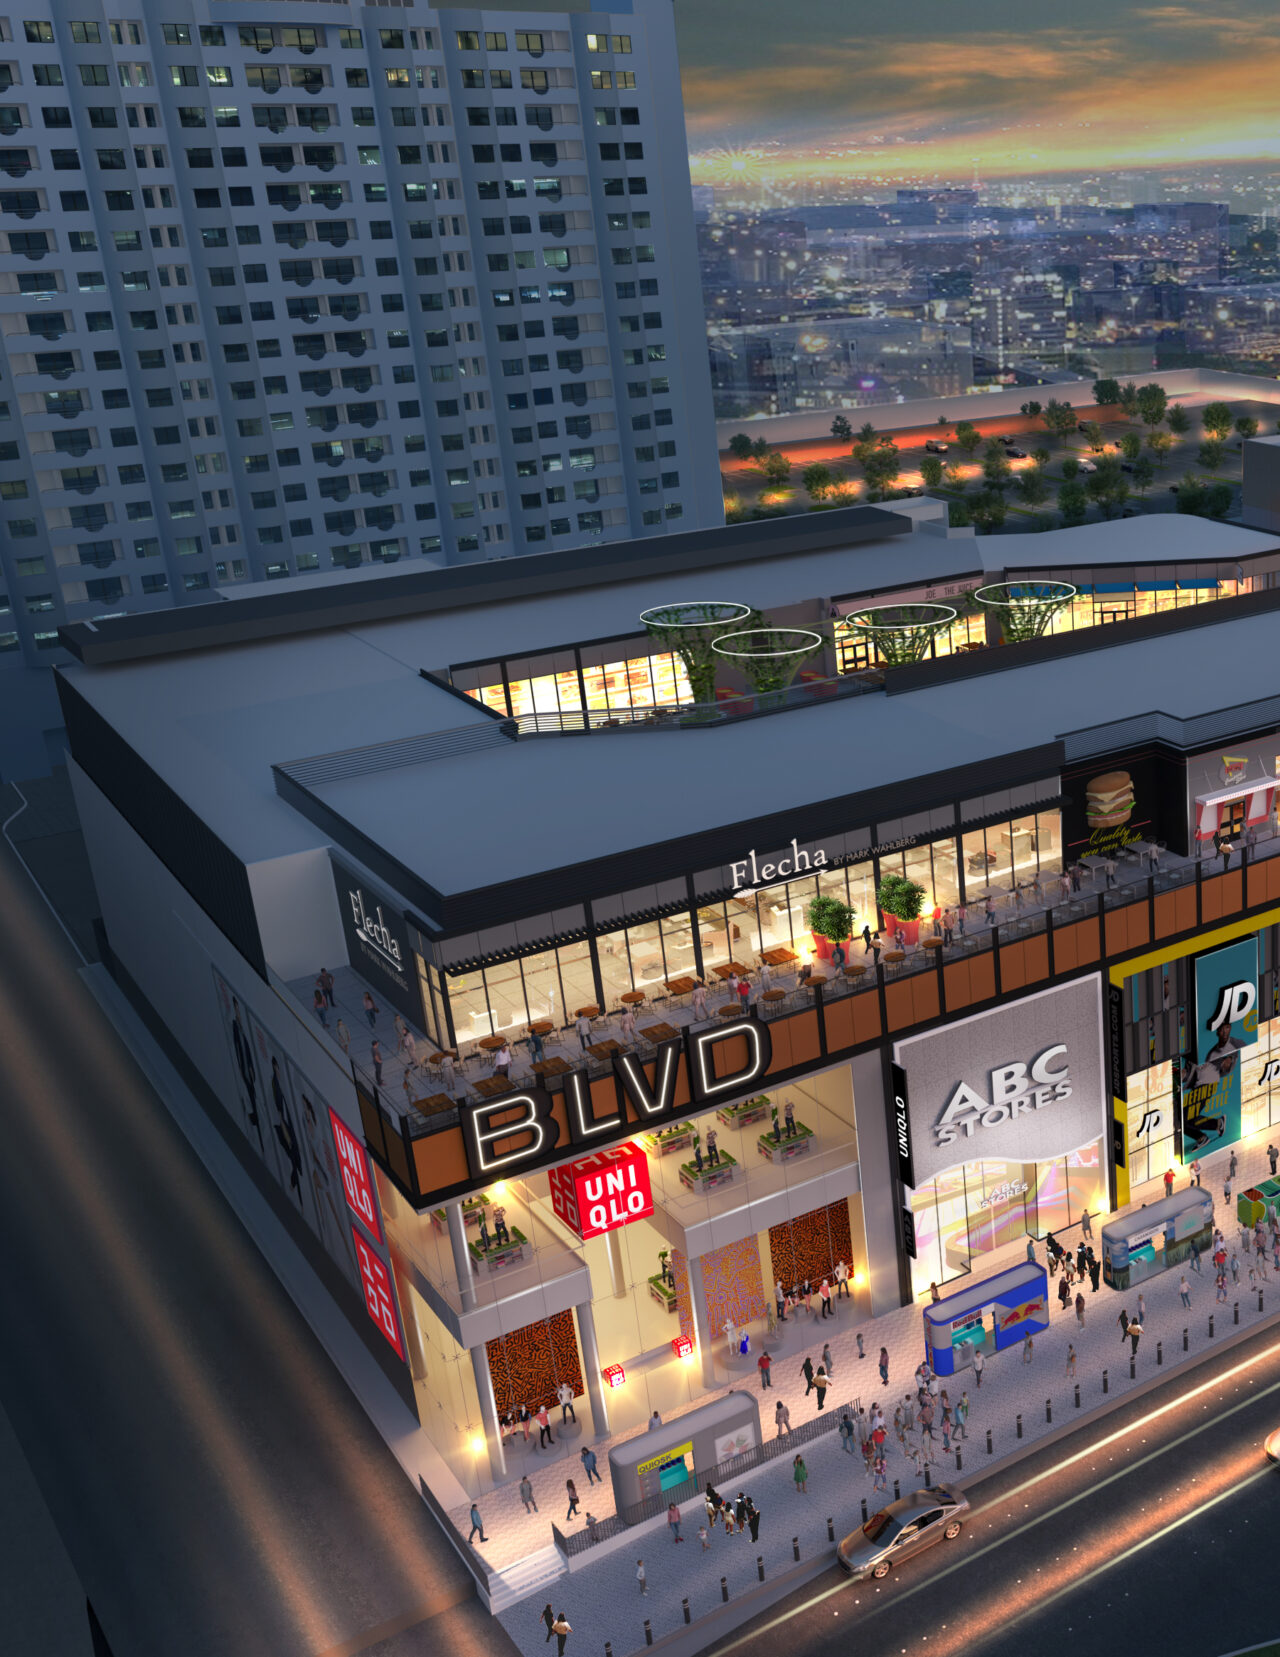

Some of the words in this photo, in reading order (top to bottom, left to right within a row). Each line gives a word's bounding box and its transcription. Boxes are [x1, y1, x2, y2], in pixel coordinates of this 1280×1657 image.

[925, 590, 937, 599] JOE
[944, 586, 955, 596] THE
[729, 837, 829, 890] Flecha
[833, 855, 844, 866] BY
[846, 850, 870, 863] MARK
[871, 836, 917, 856] WAHLBERG
[348, 889, 402, 961] Flecha
[1207, 980, 1257, 1032] JD
[467, 1020, 768, 1174] BLVD
[938, 1043, 1068, 1126] ABC
[1183, 1081, 1218, 1107] DEFINED
[1222, 1073, 1234, 1091] BY
[1187, 1103, 1201, 1120] MY
[1204, 1091, 1229, 1113] STYLE
[895, 1095, 909, 1158] UNIQLO
[934, 1079, 1073, 1148] STORES
[1137, 1109, 1162, 1137] JD
[334, 1123, 365, 1183] UNI
[343, 1165, 373, 1223] QLO
[585, 1164, 637, 1201] UNI
[589, 1190, 644, 1229] QLO
[638, 1453, 672, 1473] QUIOSK
